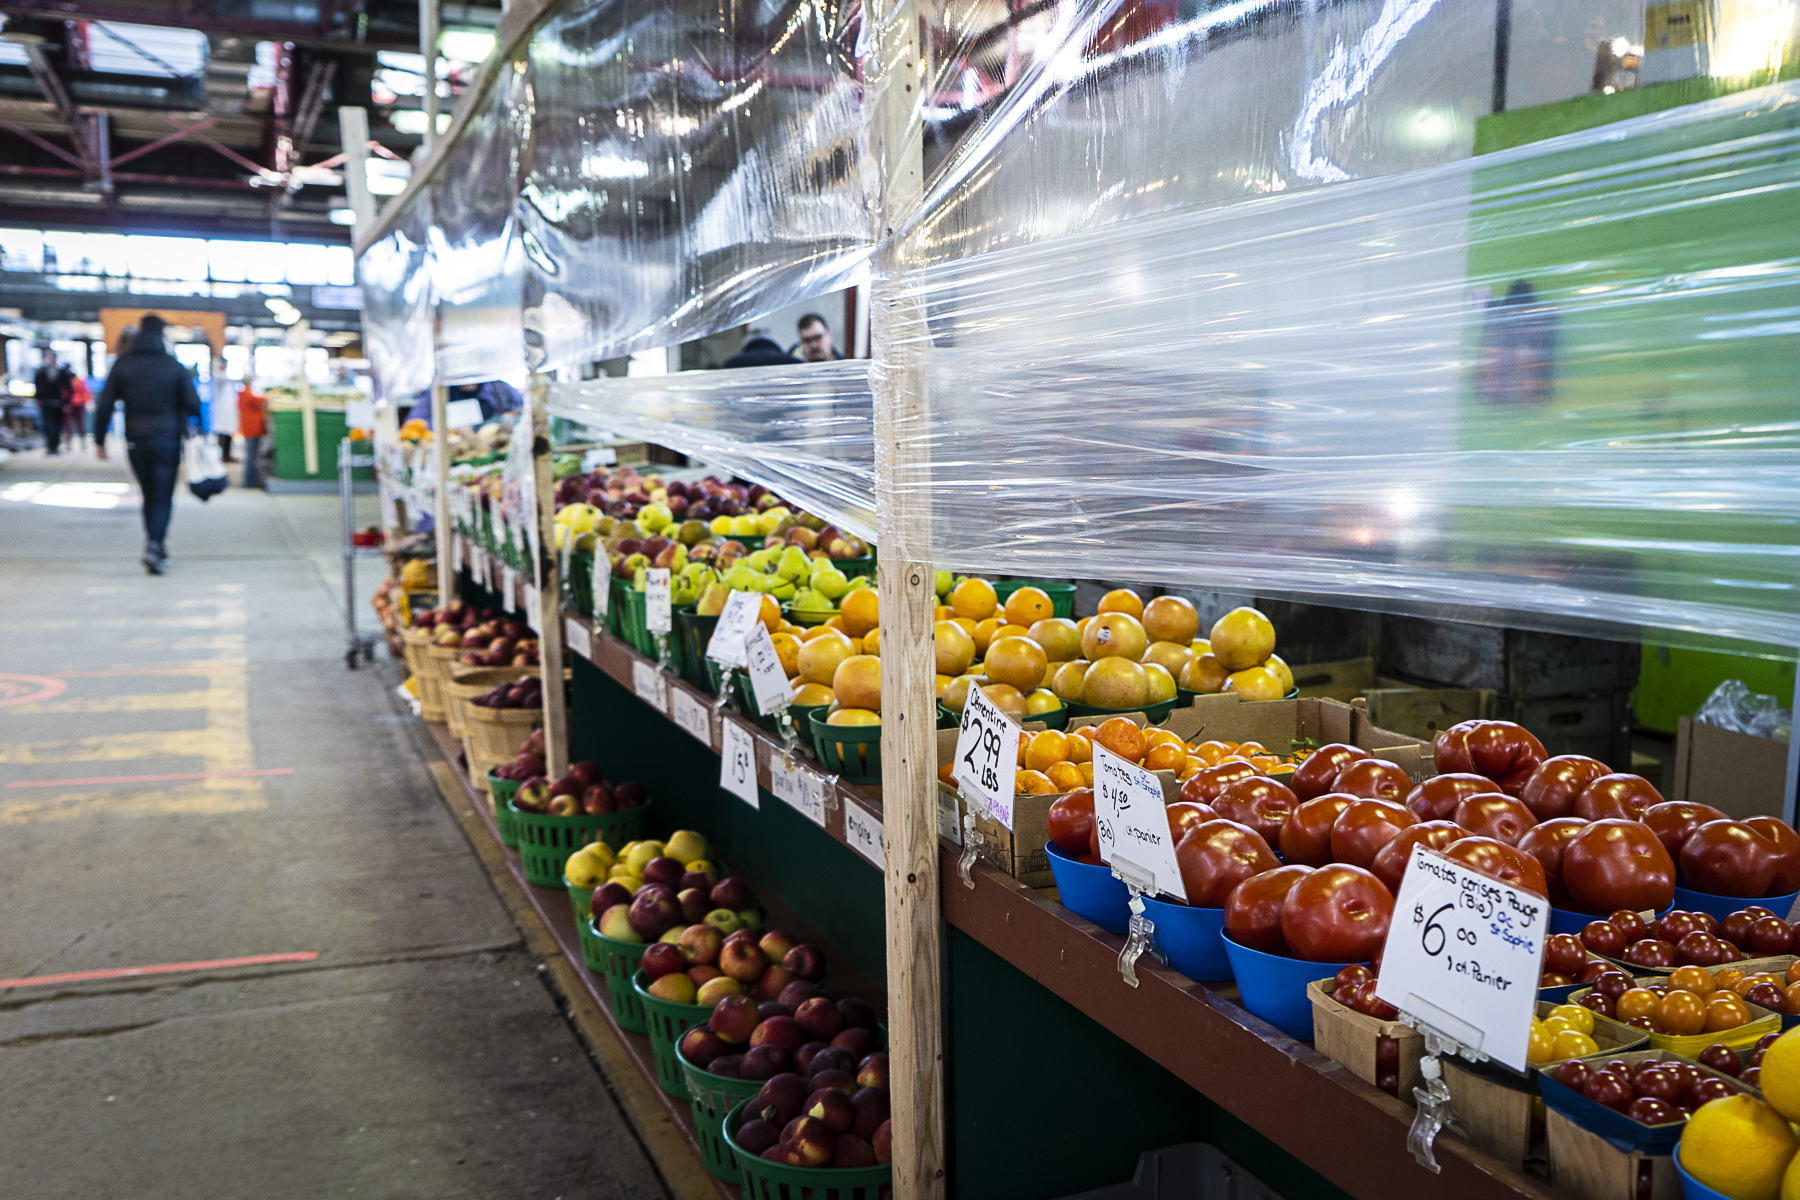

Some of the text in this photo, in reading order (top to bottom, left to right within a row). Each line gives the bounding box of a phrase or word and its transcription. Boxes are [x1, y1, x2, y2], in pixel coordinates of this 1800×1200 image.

[981, 764, 999, 792] LBS
[1100, 754, 1132, 786] Tomates
[1417, 852, 1539, 928] Tomates cerises Rouge
[1459, 890, 1494, 919] (Bio)
